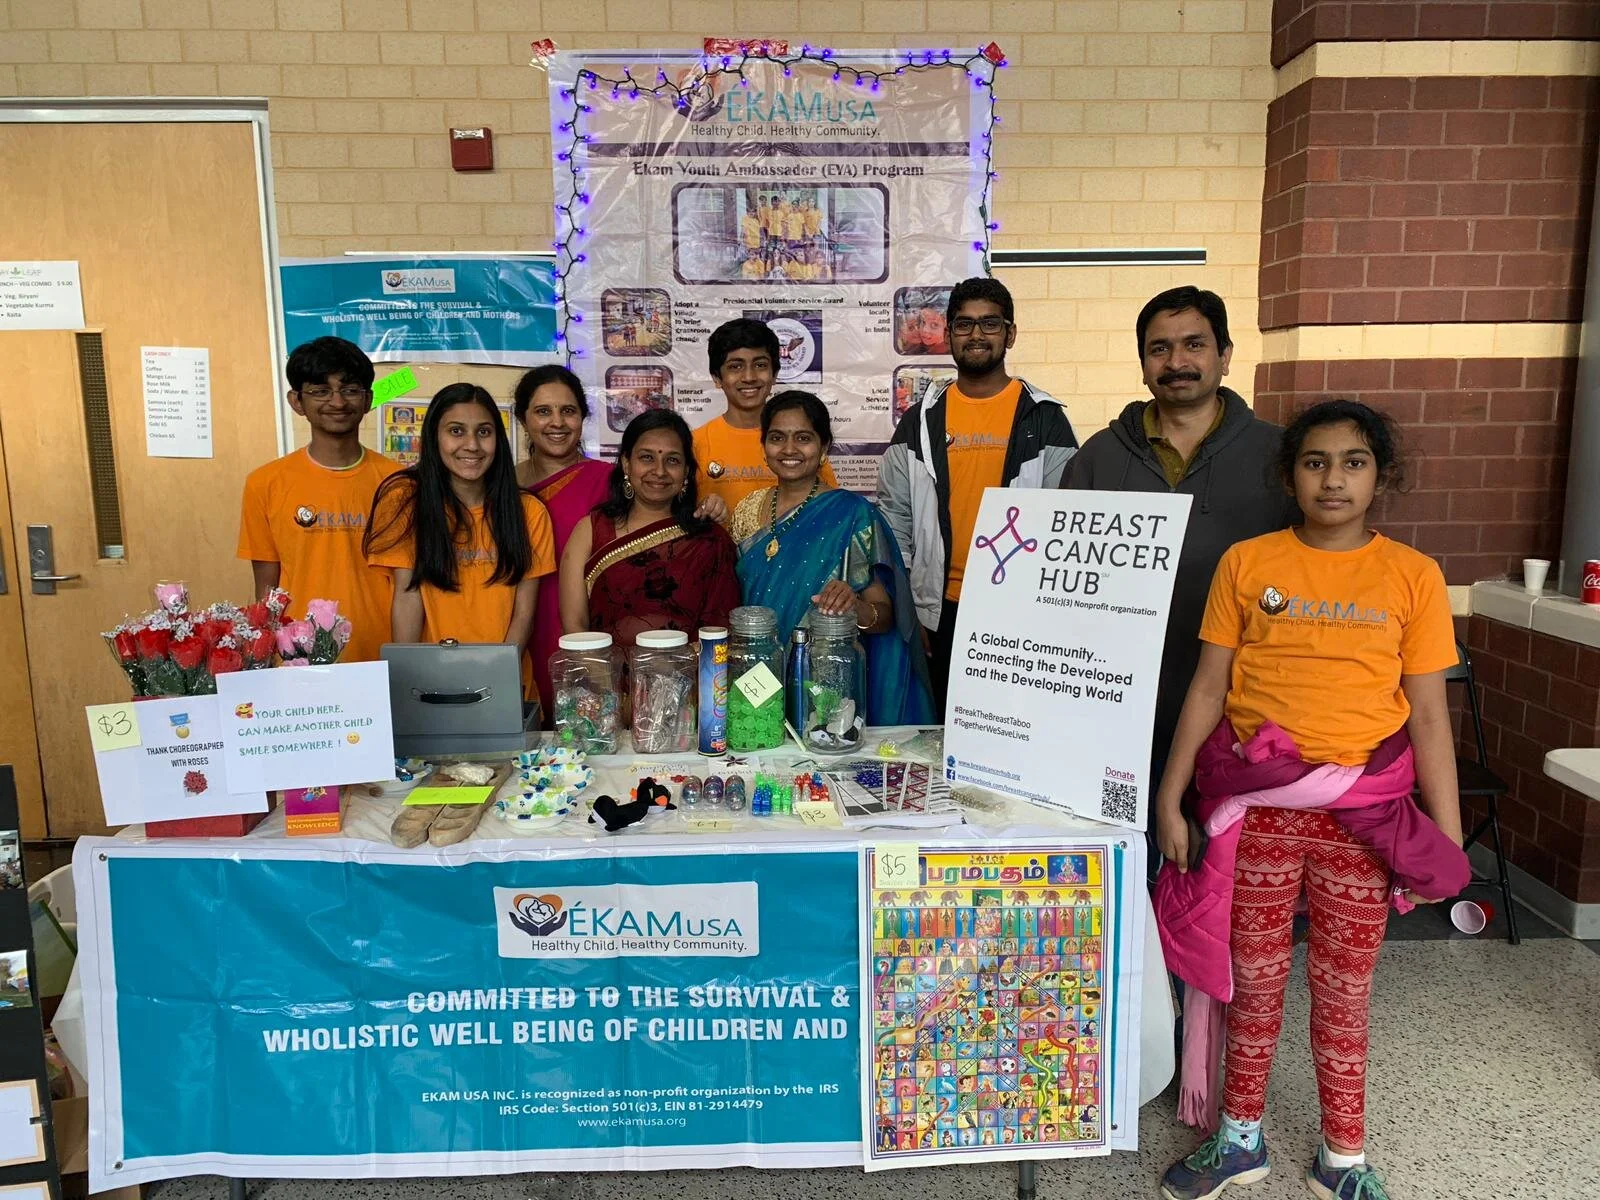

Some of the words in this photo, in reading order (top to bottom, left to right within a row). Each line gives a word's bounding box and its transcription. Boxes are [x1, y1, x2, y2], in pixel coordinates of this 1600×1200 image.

[691, 124, 733, 138] Healthy
[737, 124, 766, 136] Child.
[770, 125, 811, 138] Healthy
[815, 125, 880, 138] Community.
[632, 160, 673, 176] Ekam
[677, 160, 720, 176] Youth
[724, 161, 817, 176] Ambassador
[821, 162, 858, 178] (EYA)
[863, 163, 924, 178] Program
[358, 302, 407, 311] COMMITTED
[436, 301, 473, 310] SURVIVAL
[475, 301, 482, 309] &
[869, 309, 890, 317] locally
[321, 313, 364, 323] WHOLISTIC
[366, 313, 387, 321] WELL
[389, 312, 412, 320] BEING
[426, 311, 463, 319] CHILDREN
[464, 311, 481, 319] AND
[482, 311, 521, 320] MOTHERS
[381, 370, 412, 396] SALE
[1051, 510, 1168, 539] BREAST
[1044, 538, 1171, 571] CANCER
[1038, 567, 1101, 595] HUB
[1035, 595, 1042, 604] A
[1042, 596, 1073, 608] 501(c)(3)
[1074, 599, 1109, 612] Nonprofit
[1110, 604, 1157, 617] organization
[1267, 618, 1294, 627] Healthy
[1318, 620, 1345, 631] Healthy
[969, 632, 978, 643] A
[981, 633, 1019, 649] Global
[967, 648, 1034, 671] Connecting
[1037, 658, 1057, 673] the
[1060, 663, 1133, 686] Developed
[744, 675, 766, 697] $1
[965, 666, 987, 679] and
[989, 668, 1008, 682] the
[1011, 672, 1081, 698] Developing
[1085, 684, 1123, 703] World
[255, 709, 283, 719] YOUR
[285, 706, 314, 717] CHILD
[954, 705, 1031, 729] #BreakTheBreastTaboo
[98, 710, 132, 736] $3
[238, 727, 261, 737] CAN
[263, 724, 292, 735] MAKE
[294, 720, 341, 732] ANOTHER
[343, 717, 373, 728] CHILD
[953, 717, 1030, 742] #TogetherWeSaveLives
[146, 746, 169, 756] THANK
[168, 741, 225, 754] CHOREOGRAPHER
[239, 746, 270, 757] SMILE
[272, 740, 334, 754] SOMEWHERE
[170, 758, 187, 768] WITH
[187, 756, 209, 767] ROSES
[1105, 766, 1136, 781] Donate
[881, 852, 906, 878] $5
[927, 858, 1045, 885] பரமபதம்
[531, 939, 580, 954] Healthy
[583, 939, 618, 951] Child.
[621, 939, 670, 953] Healthy
[673, 938, 747, 952] Community.
[407, 986, 576, 1013] COMMITTED
[585, 986, 620, 1008] TO
[628, 985, 679, 1008] THE
[689, 985, 821, 1008] SURVIVAL
[831, 985, 850, 1007] &
[262, 1024, 419, 1053] WHOLISTIC
[429, 1021, 502, 1047] WELL
[512, 1019, 594, 1043] BEING
[604, 1018, 638, 1042] OF
[649, 1018, 783, 1042] CHILDREN
[792, 1018, 848, 1041] AND
[422, 1091, 460, 1103] EKAM
[463, 1090, 490, 1101] USA
[492, 1090, 519, 1101] INC.
[521, 1089, 531, 1099] is
[534, 1088, 605, 1102] recognized
[607, 1089, 621, 1098] as
[623, 1086, 688, 1098] non-profit
[690, 1085, 771, 1098] organization
[774, 1085, 790, 1098] by
[792, 1084, 814, 1095] the
[819, 1083, 839, 1094] IRS
[499, 1105, 519, 1116] IRS
[522, 1103, 559, 1114] Code:
[561, 1103, 609, 1113] Section
[612, 1101, 662, 1113] 501(c)3,
[664, 1101, 686, 1111] EIN
[688, 1099, 764, 1111] 81-2914479
[577, 1115, 687, 1128] www.ekamusa.org
